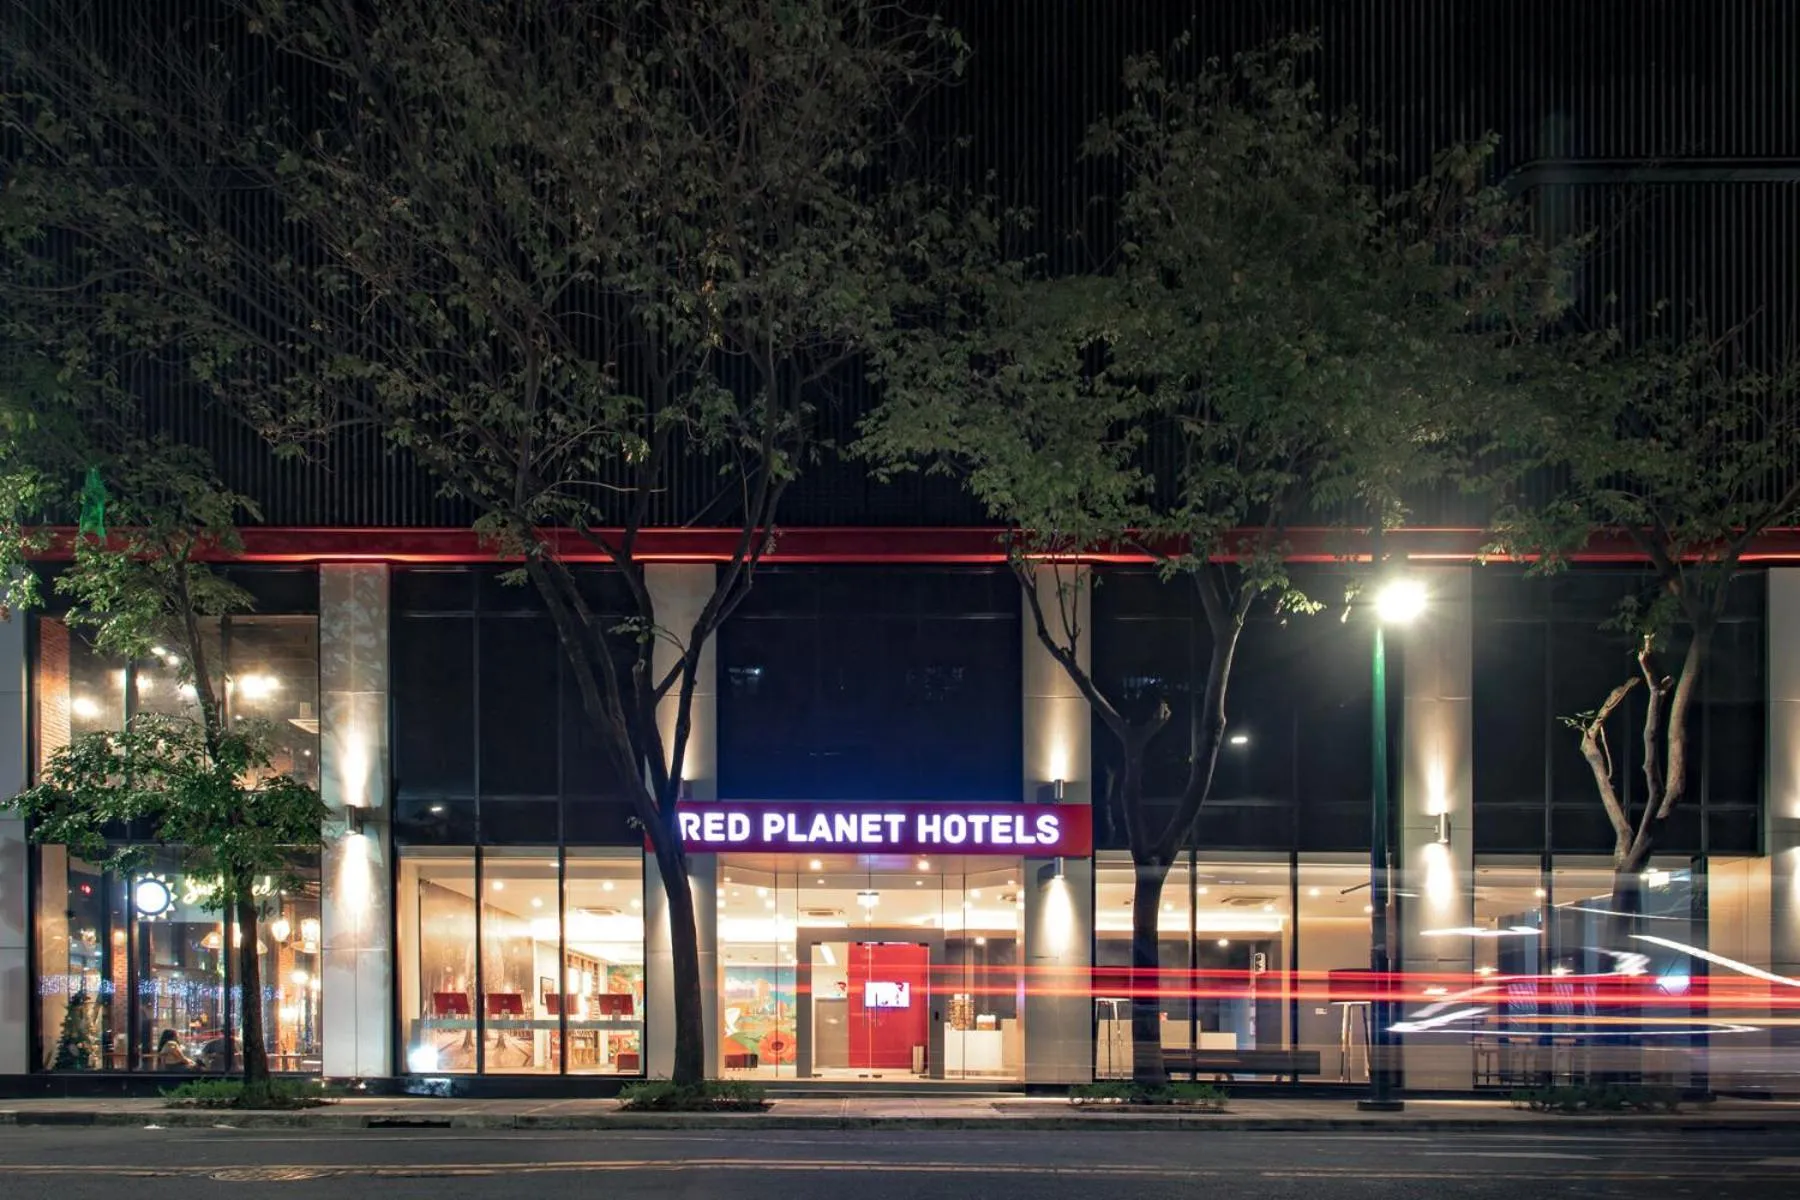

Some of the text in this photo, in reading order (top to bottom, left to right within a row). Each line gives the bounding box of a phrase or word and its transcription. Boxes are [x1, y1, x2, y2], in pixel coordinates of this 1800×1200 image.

[678, 812, 1060, 844] RED PLANET HOTELS
